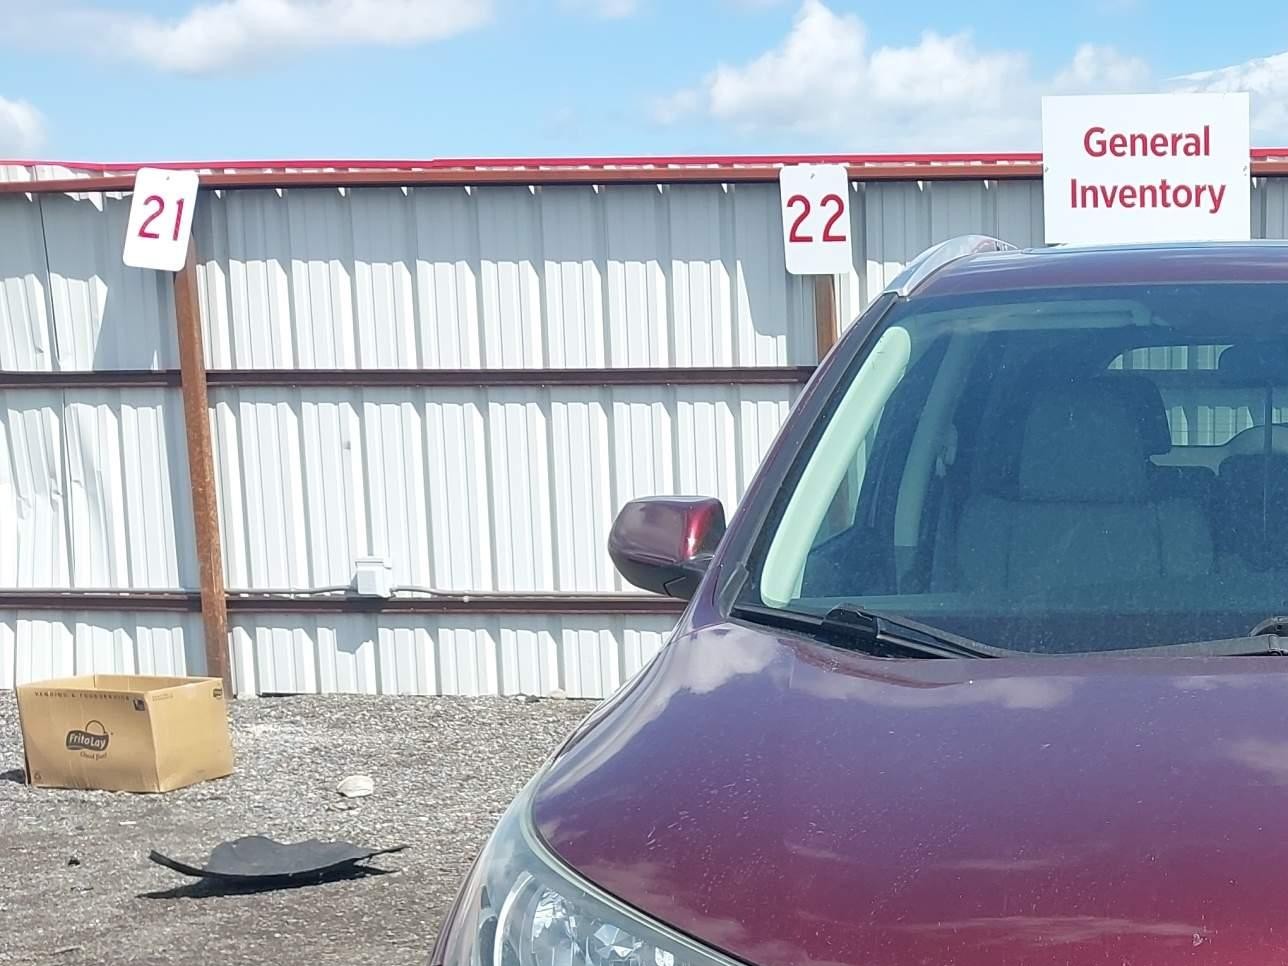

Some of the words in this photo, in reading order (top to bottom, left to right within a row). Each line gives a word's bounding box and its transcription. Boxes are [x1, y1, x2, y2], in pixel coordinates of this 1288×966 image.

[1083, 125, 1211, 158] General
[1070, 178, 1227, 214] Inventory
[138, 194, 185, 242] 21
[786, 193, 847, 243] 22
